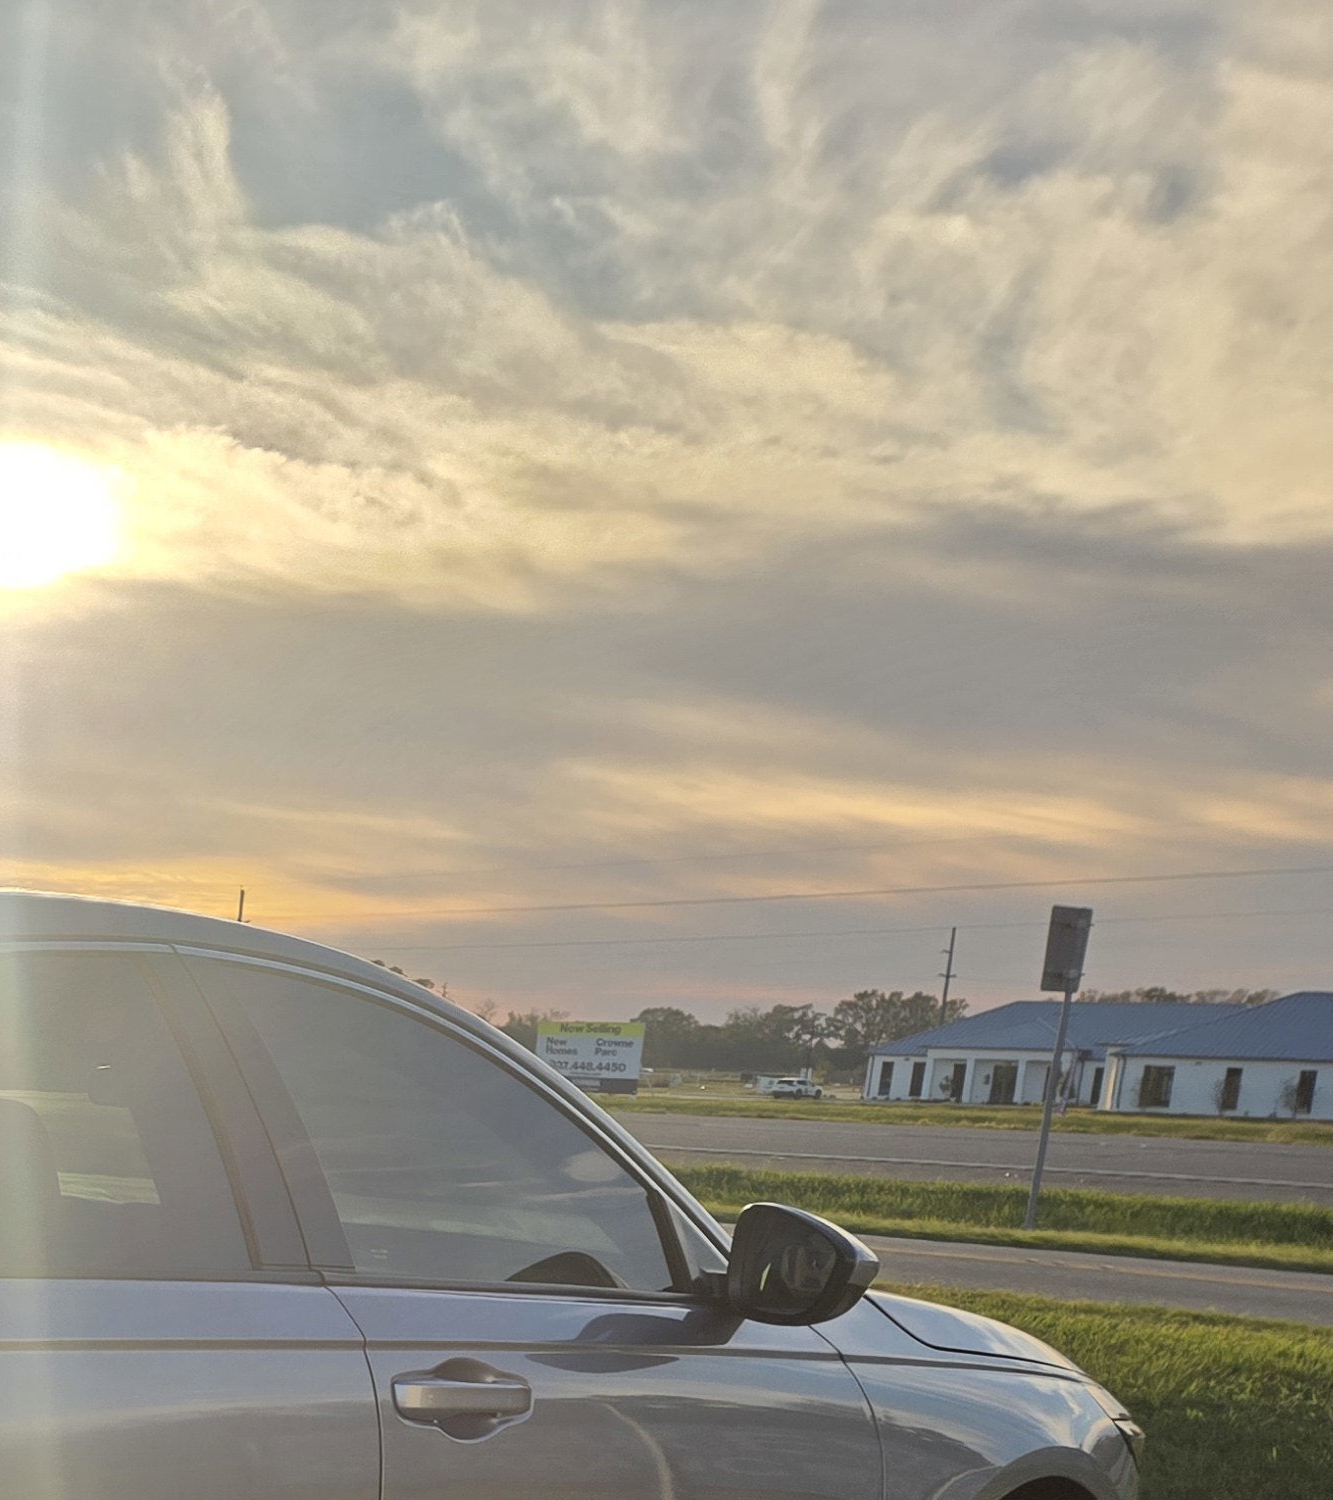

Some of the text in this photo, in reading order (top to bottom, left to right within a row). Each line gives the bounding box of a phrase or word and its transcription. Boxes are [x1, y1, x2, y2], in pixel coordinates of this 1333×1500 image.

[560, 1023, 621, 1035] Now Selling
[546, 1036, 568, 1046] New
[546, 1046, 578, 1056] Homes
